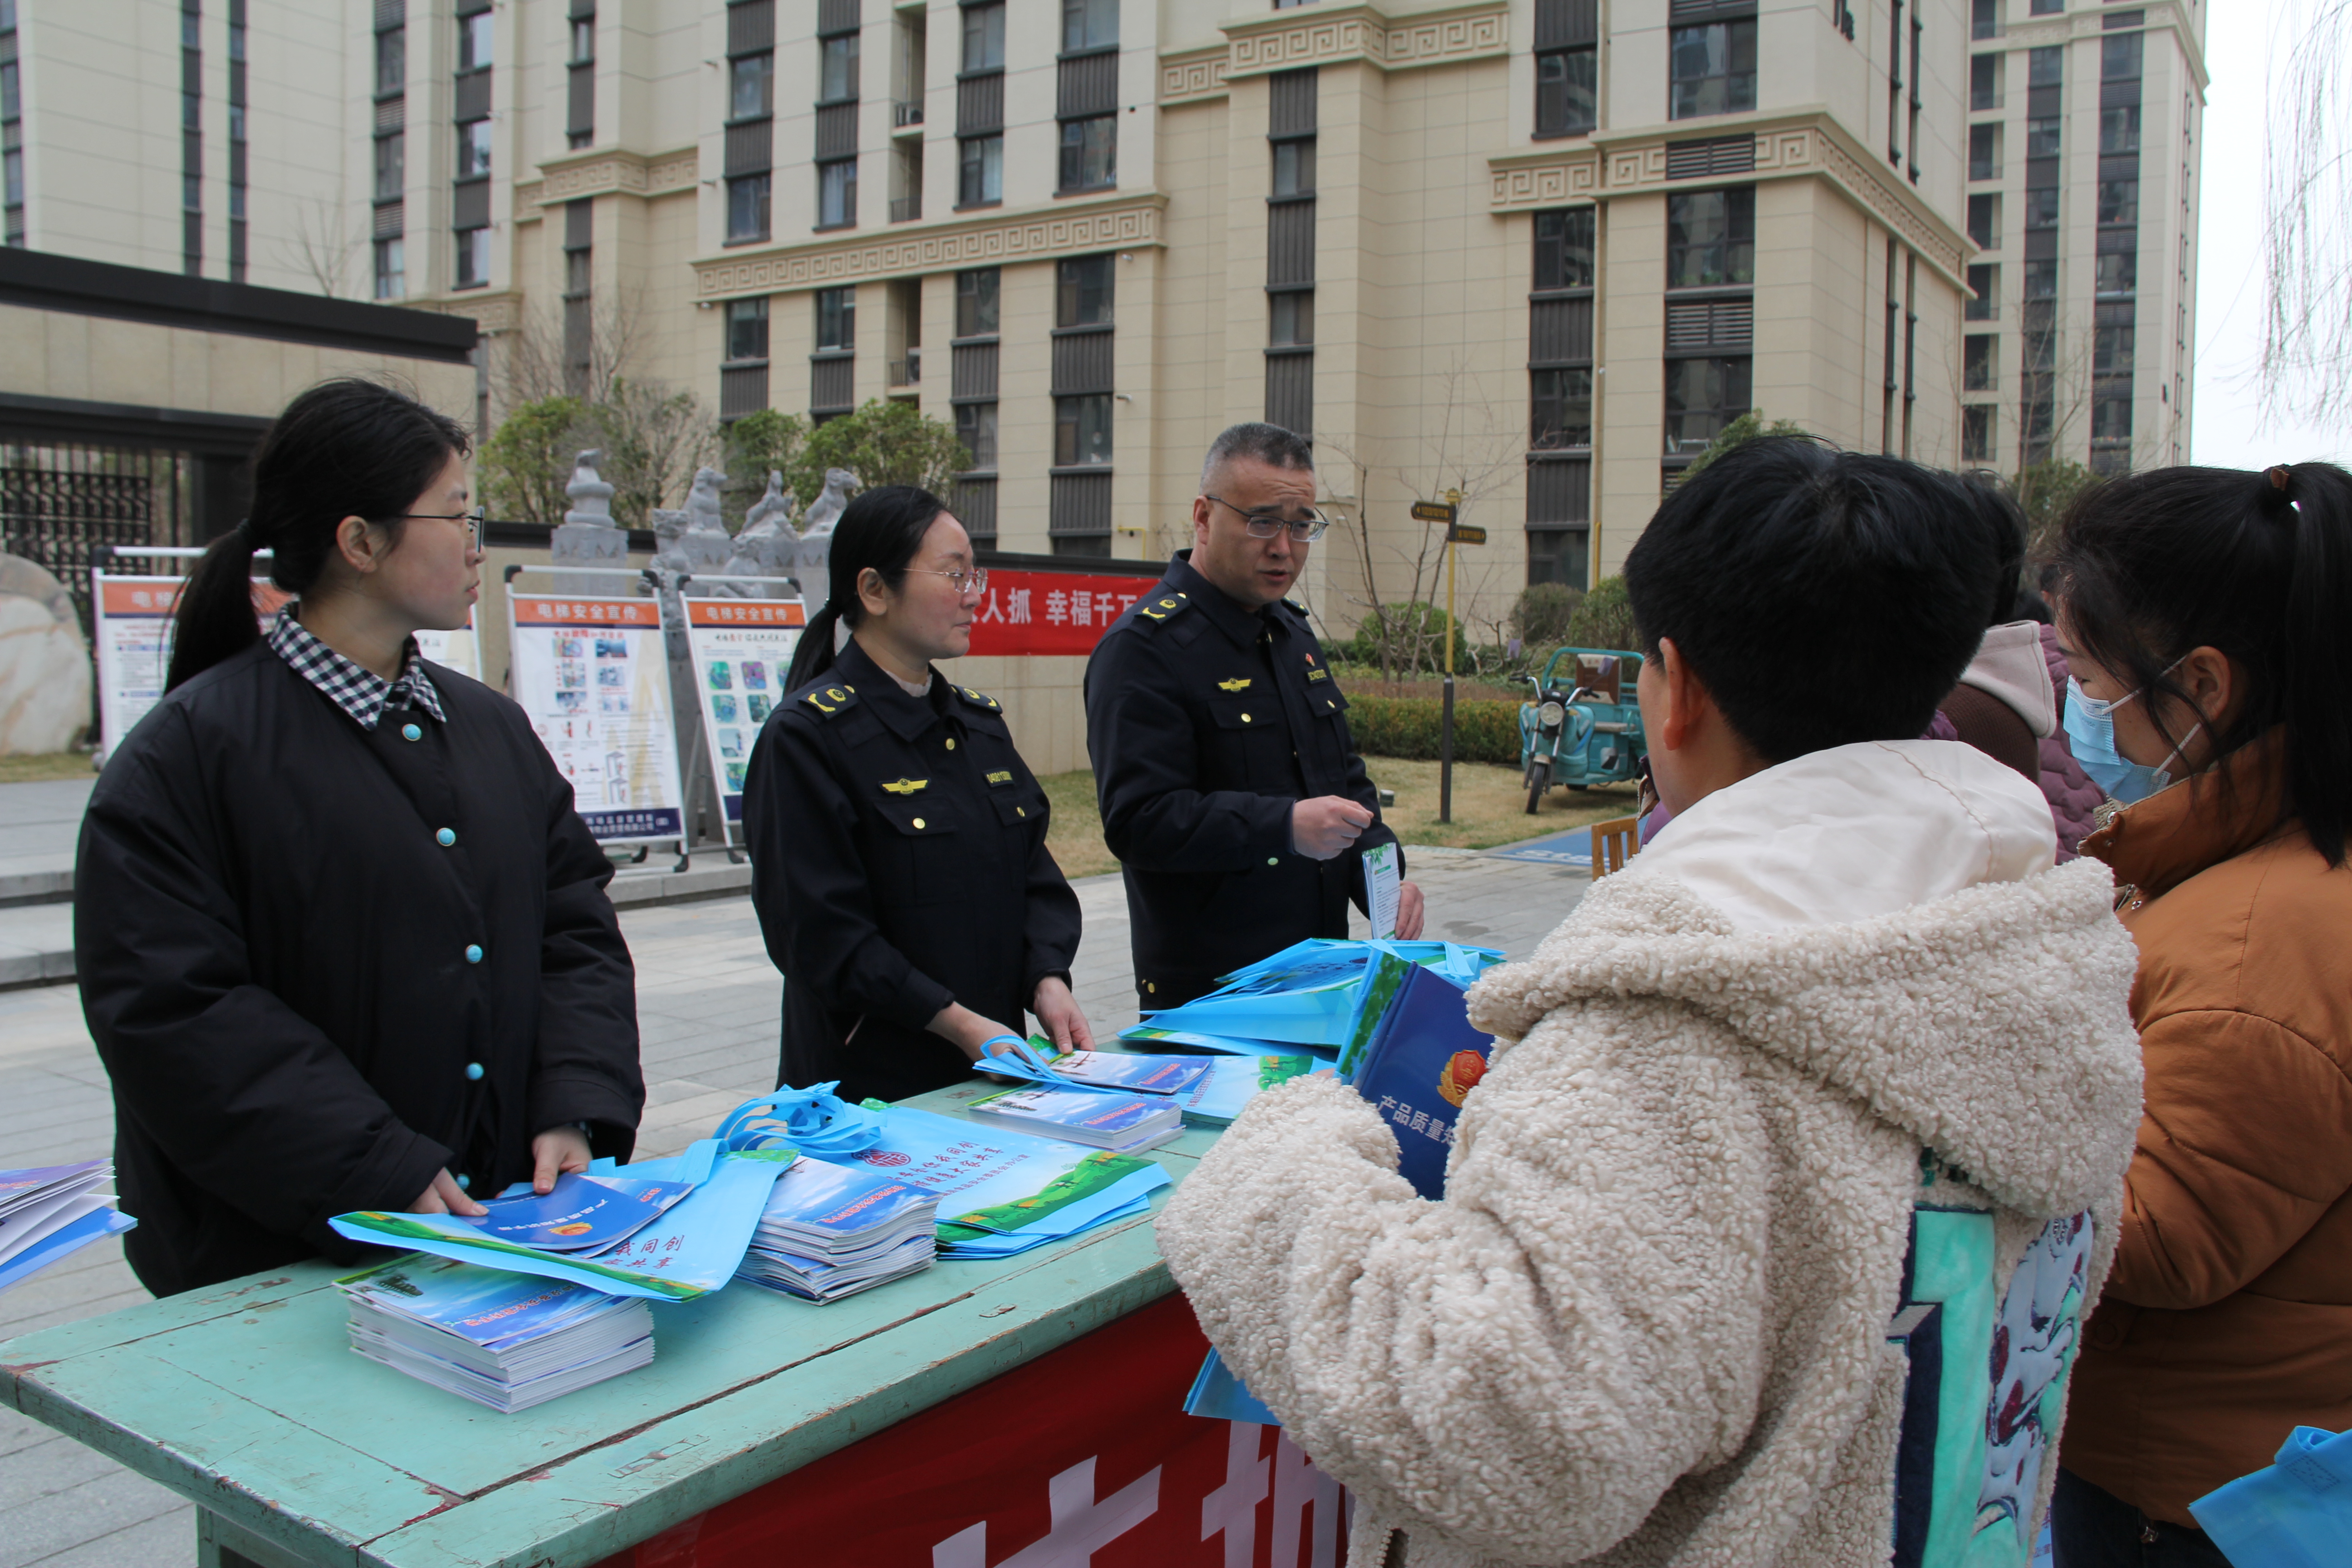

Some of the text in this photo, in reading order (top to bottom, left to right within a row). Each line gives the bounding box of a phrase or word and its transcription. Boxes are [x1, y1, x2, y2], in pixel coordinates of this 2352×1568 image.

[537, 603, 637, 620] 电梯安全宣传
[706, 607, 787, 621] 电梯安全宣传
[972, 587, 1032, 624] 人抓
